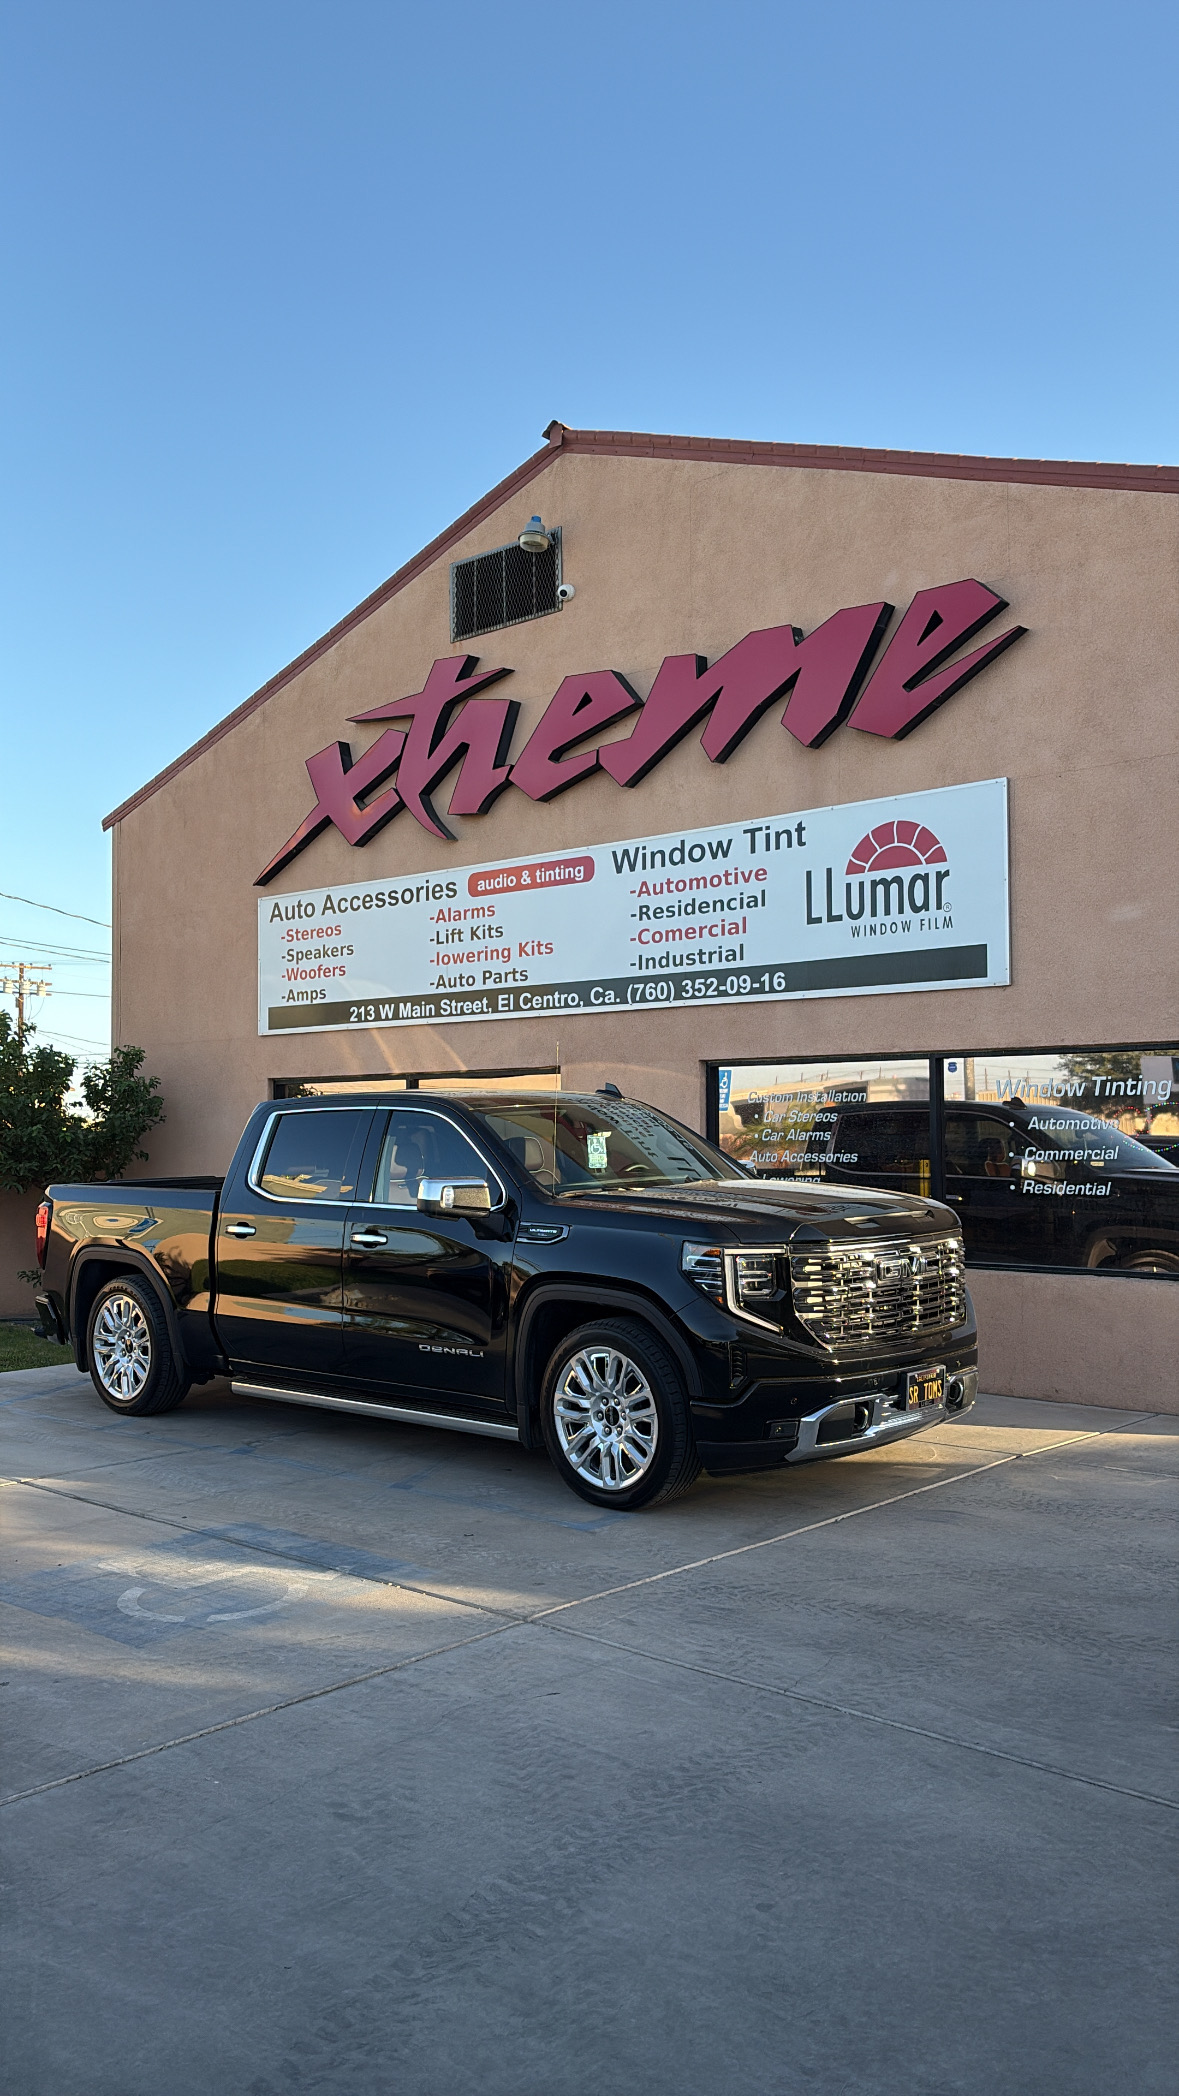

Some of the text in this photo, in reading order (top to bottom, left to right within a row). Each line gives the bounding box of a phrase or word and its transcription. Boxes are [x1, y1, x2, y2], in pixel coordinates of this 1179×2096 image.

[611, 820, 807, 874] Window Tint
[477, 864, 585, 891] audio & tinting
[629, 866, 768, 898] -Automotive
[269, 879, 458, 923] Auto Accessories
[630, 889, 766, 922] -Residencial
[429, 904, 496, 924] -Alarms
[280, 924, 342, 942] -Stereos
[429, 924, 504, 945] -Lift Kits
[629, 916, 747, 945] -Comercial
[851, 915, 954, 938] WINDOW FILM
[281, 944, 354, 965] -Speakers
[429, 940, 554, 966] -lowering Kits
[629, 943, 744, 971] -Industrial
[281, 964, 346, 982] -Woofers
[429, 967, 529, 990] -Auto Parts
[281, 988, 327, 1003] -Amps
[350, 971, 786, 1022] 213 W Main Street, El Centro, Ca. (760) 352-09-16
[747, 1089, 867, 1103] Custom Installation
[995, 1075, 1172, 1101] Window Tinting
[763, 1110, 838, 1123] Car Stereos
[1027, 1116, 1120, 1130] Automotive
[761, 1128, 832, 1141] Car Alarms
[749, 1149, 858, 1163] Auto Accessories
[1024, 1146, 1119, 1161] Commercial
[1022, 1180, 1112, 1196] Residential
[418, 1344, 484, 1358] DENALI
[908, 1385, 919, 1404] SR
